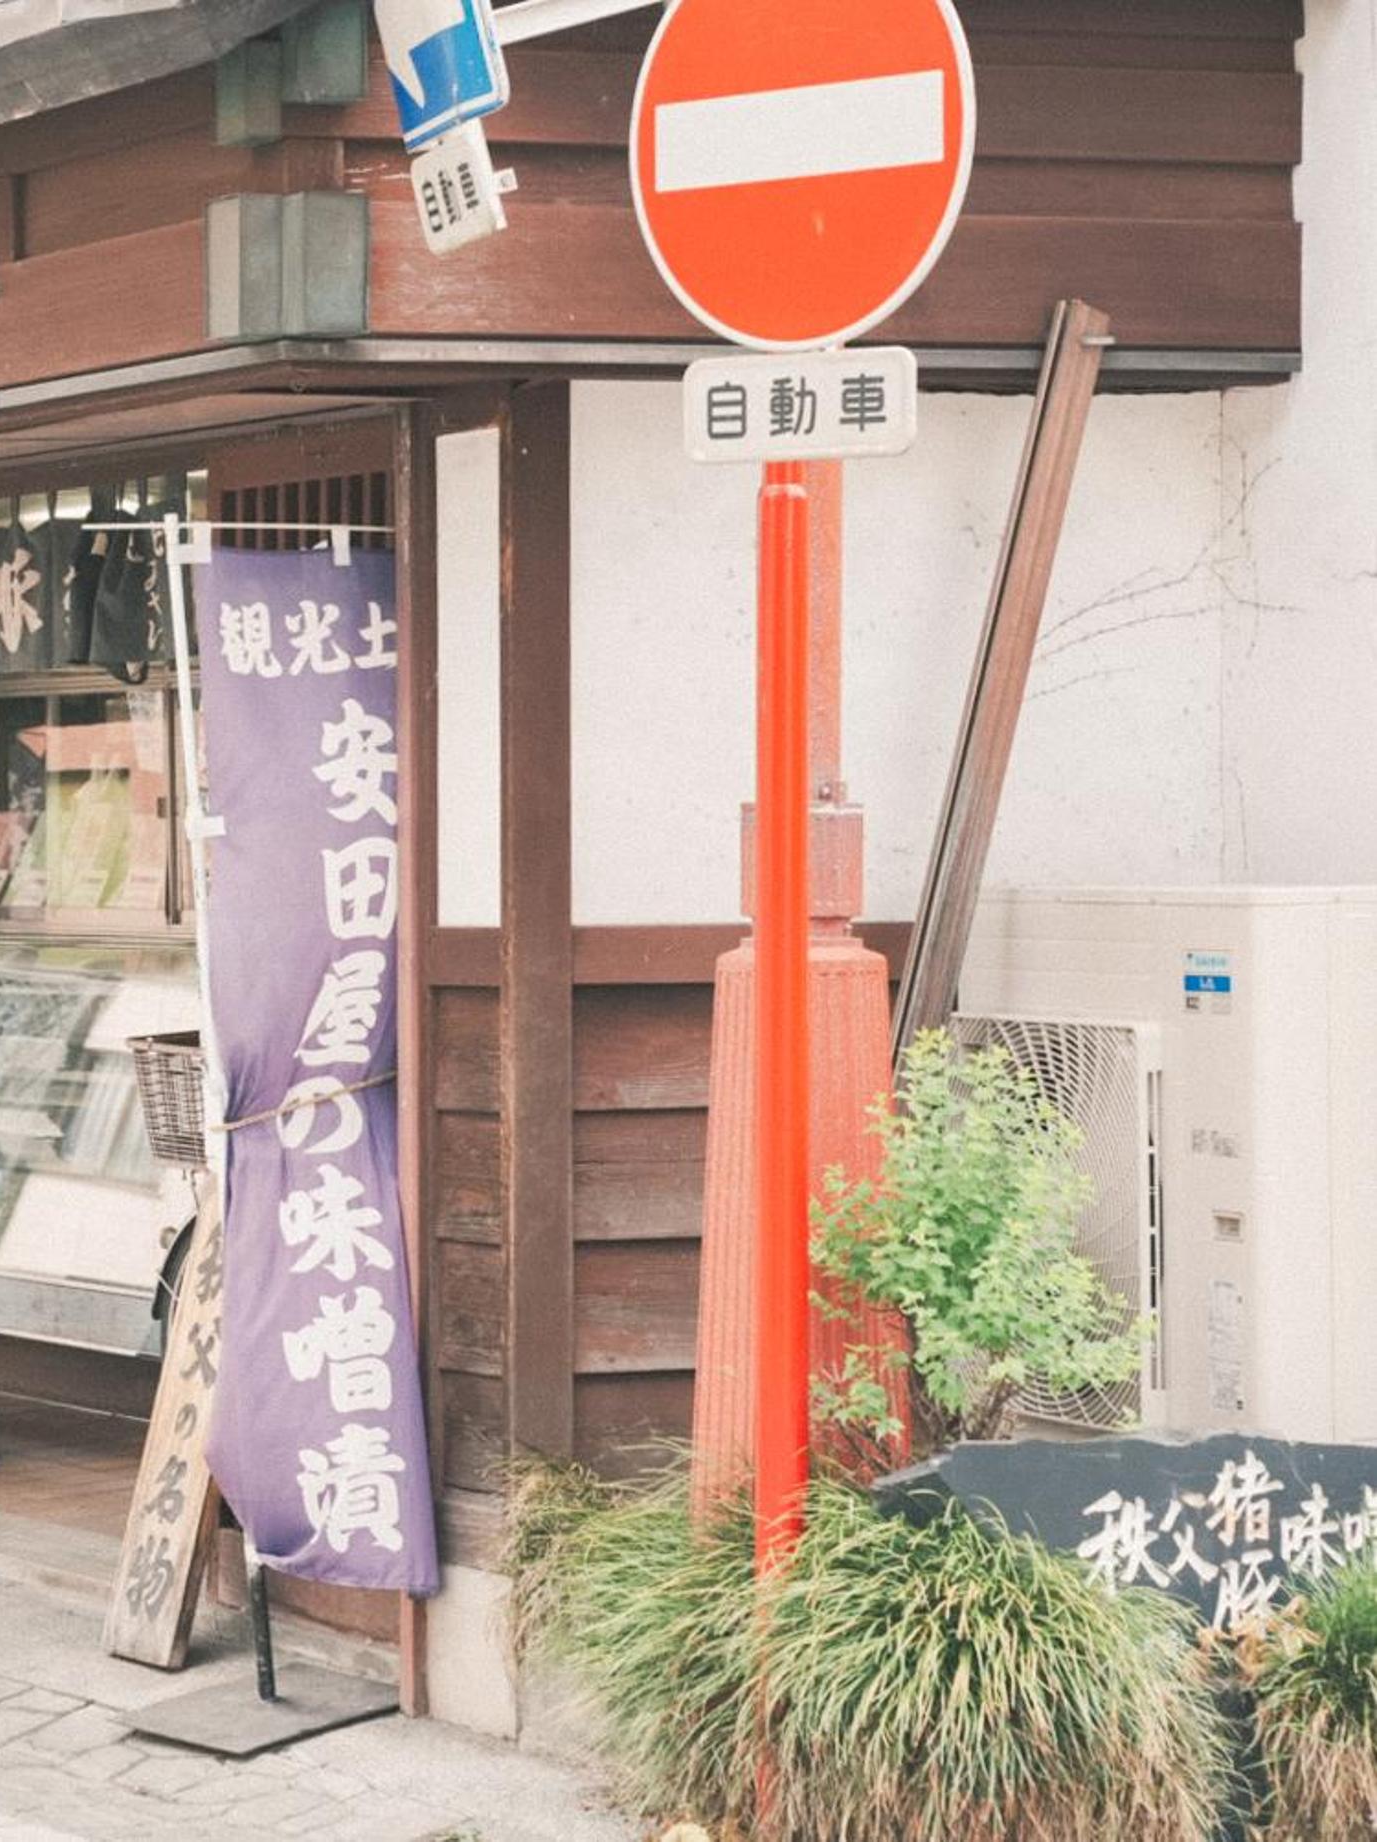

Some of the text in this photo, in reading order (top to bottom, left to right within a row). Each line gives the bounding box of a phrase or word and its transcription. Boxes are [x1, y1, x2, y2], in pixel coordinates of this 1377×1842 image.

[707, 373, 887, 439] 自動車
[275, 697, 406, 1554] 安田屋の味噌漬
